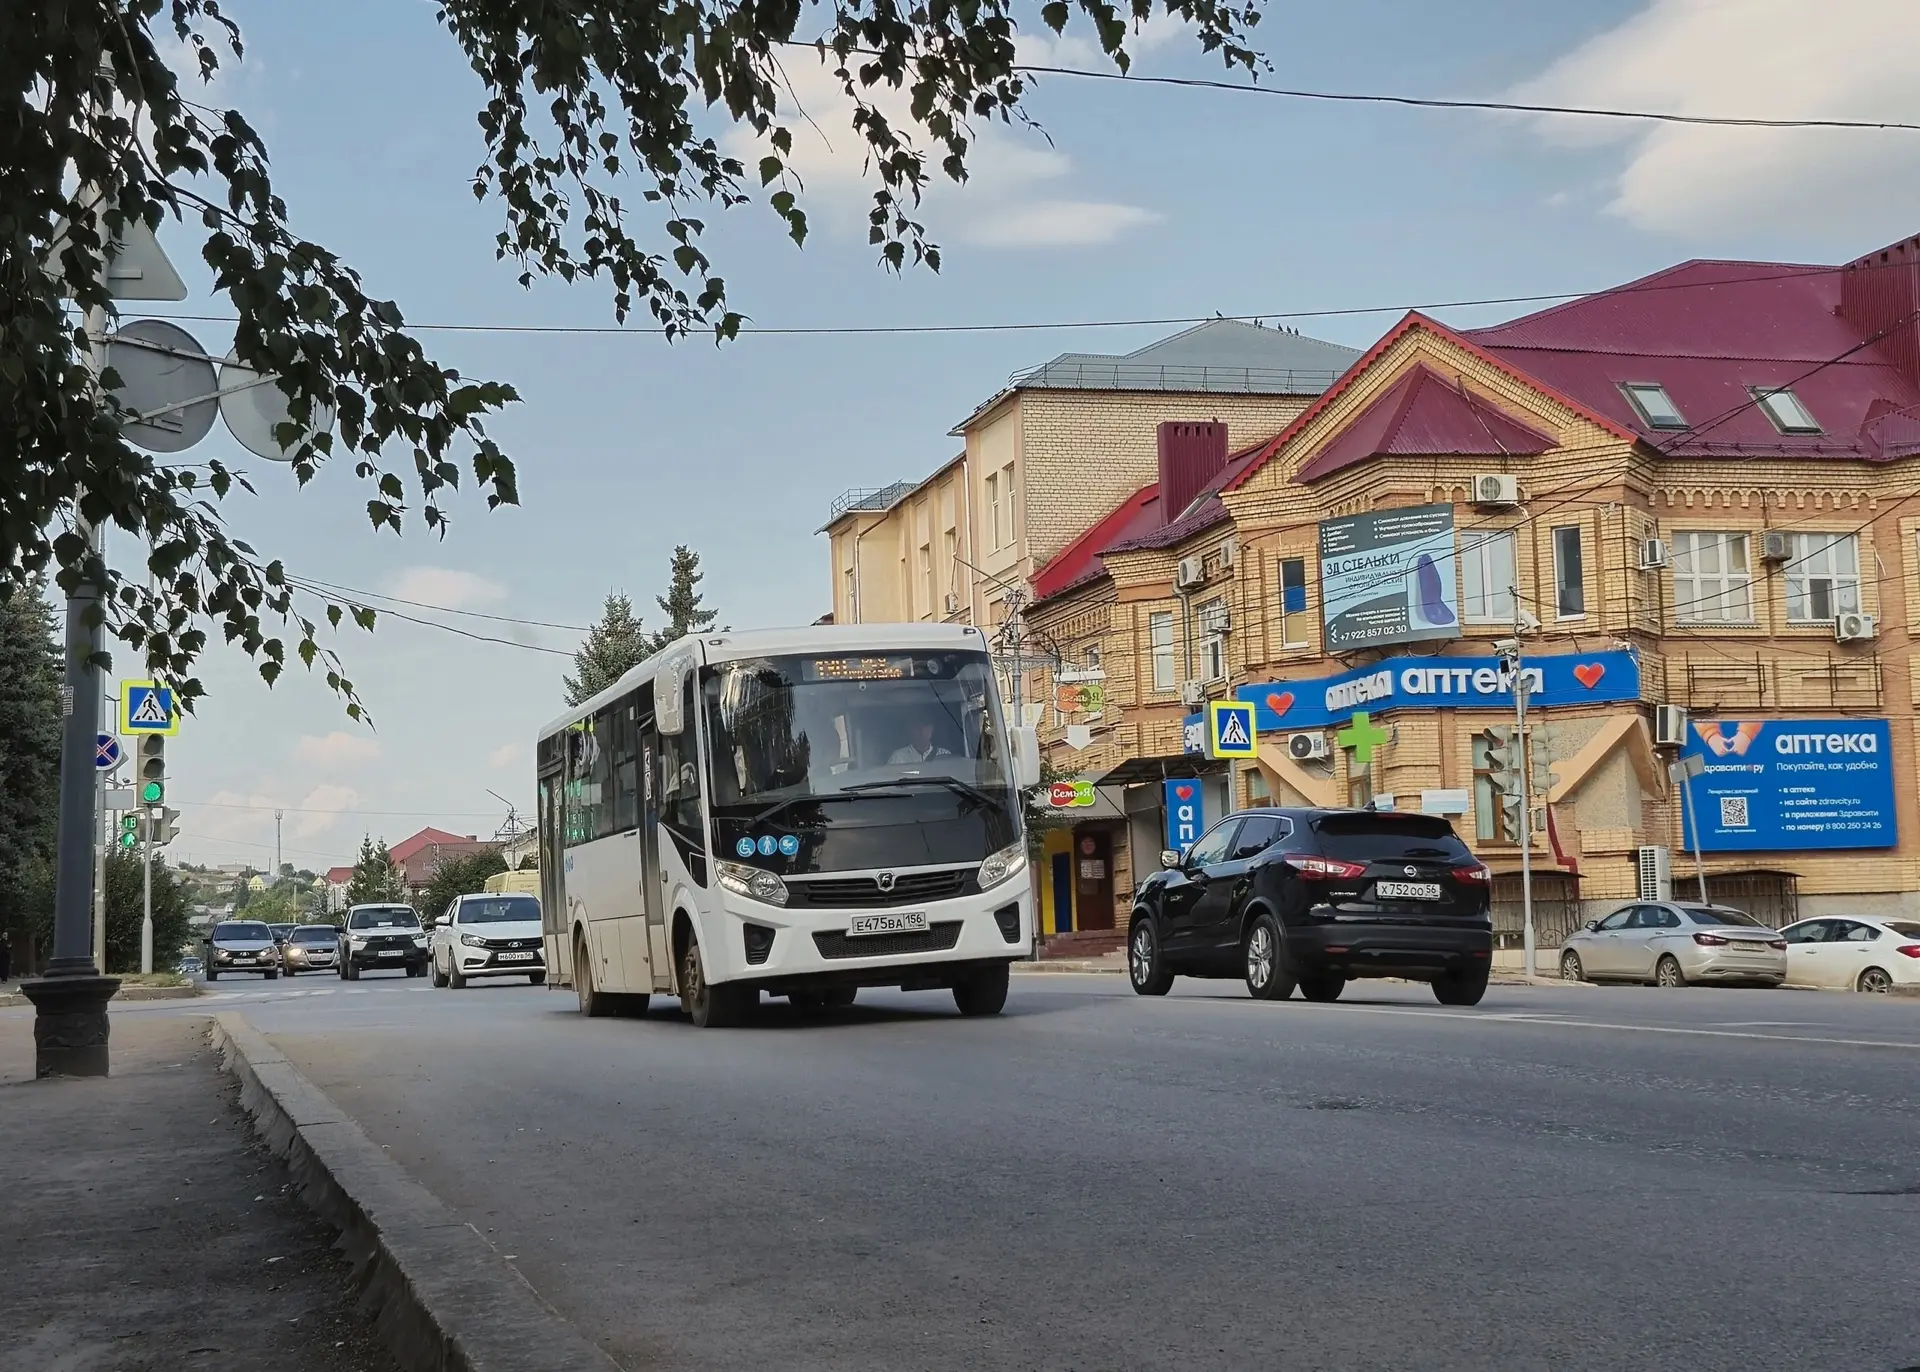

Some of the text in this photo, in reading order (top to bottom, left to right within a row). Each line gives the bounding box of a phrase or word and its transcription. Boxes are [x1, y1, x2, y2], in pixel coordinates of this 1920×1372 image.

[1342, 553, 1401, 573] СТЕЛЬКИ
[1340, 624, 1407, 641] +7 922 857 02 30
[1401, 667, 1544, 694] аптека
[1325, 670, 1393, 712] аптека
[1775, 733, 1877, 754] аптека
[1776, 762, 1827, 772] Покупайте,
[1845, 761, 1878, 772] удобно
[1795, 798, 1818, 806] сайте
[1818, 797, 1861, 806] zdravcity.ru
[1791, 811, 1838, 820] приложении
[1838, 809, 1879, 818] Здравсити
[125, 817, 136, 828] 18
[1797, 823, 1825, 832] номеру
[1825, 822, 1831, 830] 8
[1832, 822, 1846, 830] 800
[1847, 822, 1861, 830] 250
[1872, 821, 1882, 829] 26
[905, 914, 922, 924] 156
